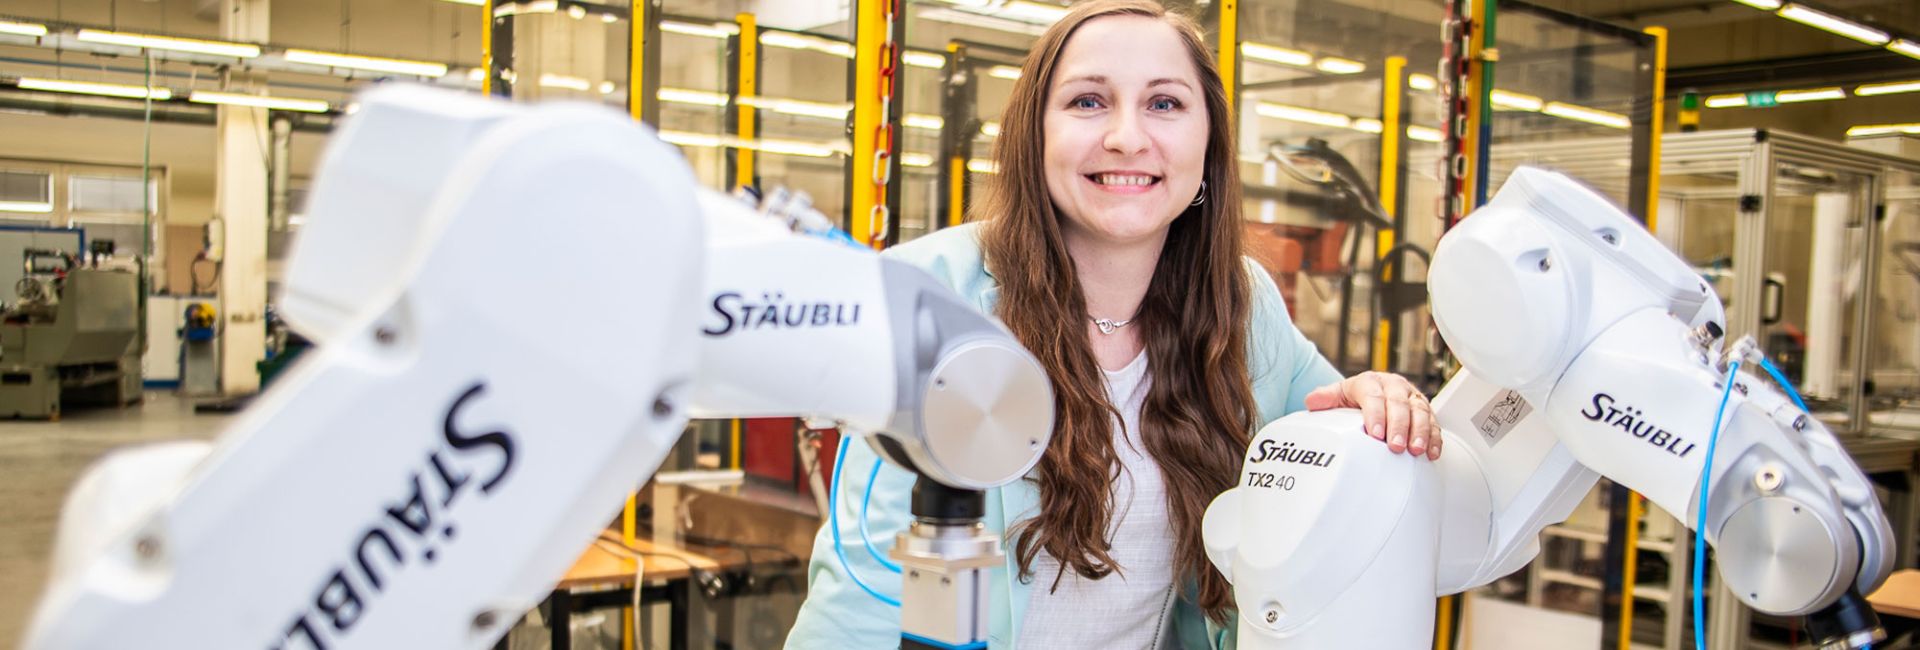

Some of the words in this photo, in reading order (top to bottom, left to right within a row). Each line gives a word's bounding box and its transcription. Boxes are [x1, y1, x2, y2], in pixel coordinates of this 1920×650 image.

[702, 292, 860, 336] STÄUBLI
[1581, 392, 1696, 459] STÄUBLI
[1249, 438, 1336, 468] STÄUBLI
[1247, 471, 1275, 488] TX2
[1275, 475, 1296, 491] 40
[269, 382, 515, 650] STÄUBL
